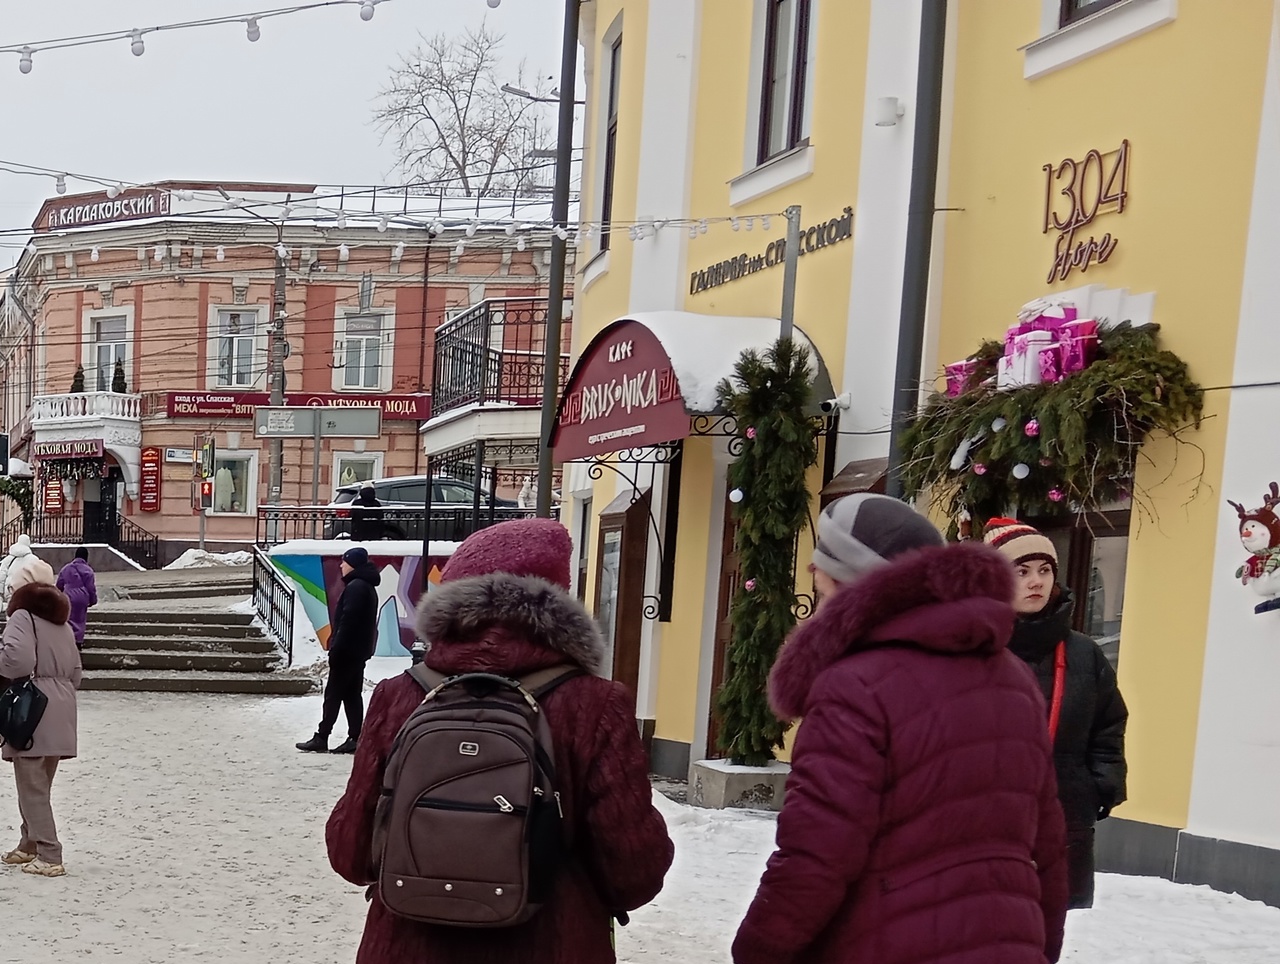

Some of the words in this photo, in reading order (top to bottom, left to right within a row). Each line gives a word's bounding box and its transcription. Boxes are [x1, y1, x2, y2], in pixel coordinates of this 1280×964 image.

[1042, 139, 1129, 234] 1304
[60, 194, 155, 225] КАРДАКОВСКИЙ
[690, 253, 748, 295] ГАЛЕРЕЯ
[765, 206, 854, 267] СПССКОЙ
[608, 340, 634, 362] КАФЕ
[174, 403, 198, 413] МЕХА
[385, 400, 417, 415] МОДА
